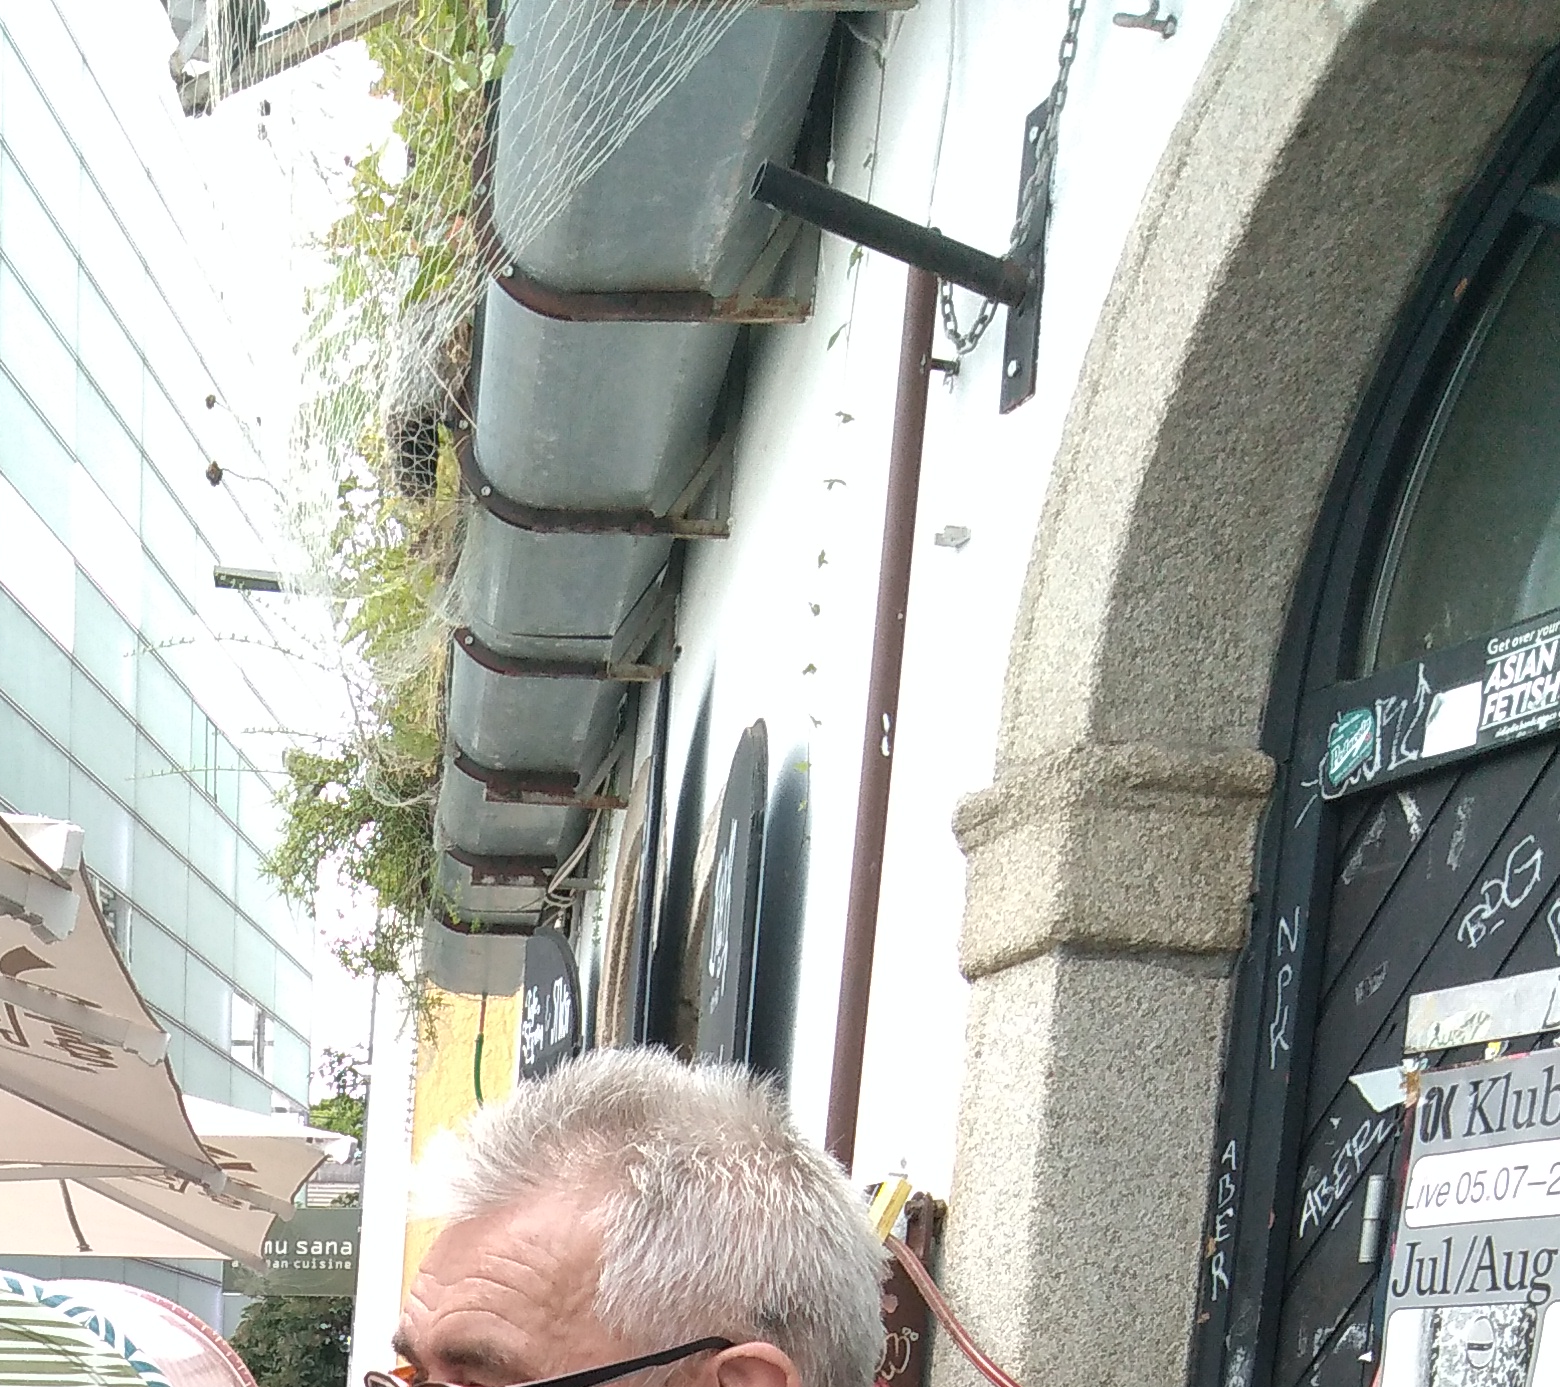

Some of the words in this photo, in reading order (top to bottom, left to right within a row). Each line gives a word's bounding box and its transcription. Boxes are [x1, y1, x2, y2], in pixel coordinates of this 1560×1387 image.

[1487, 637, 1509, 655] Get
[1511, 629, 1535, 648] over
[1484, 639, 1559, 694] ASIAN
[1462, 1065, 1560, 1138] Klub
[293, 1258, 352, 1270] cuisine
[295, 1240, 353, 1256] sana
[1391, 1234, 1559, 1305] Jul/Aug
